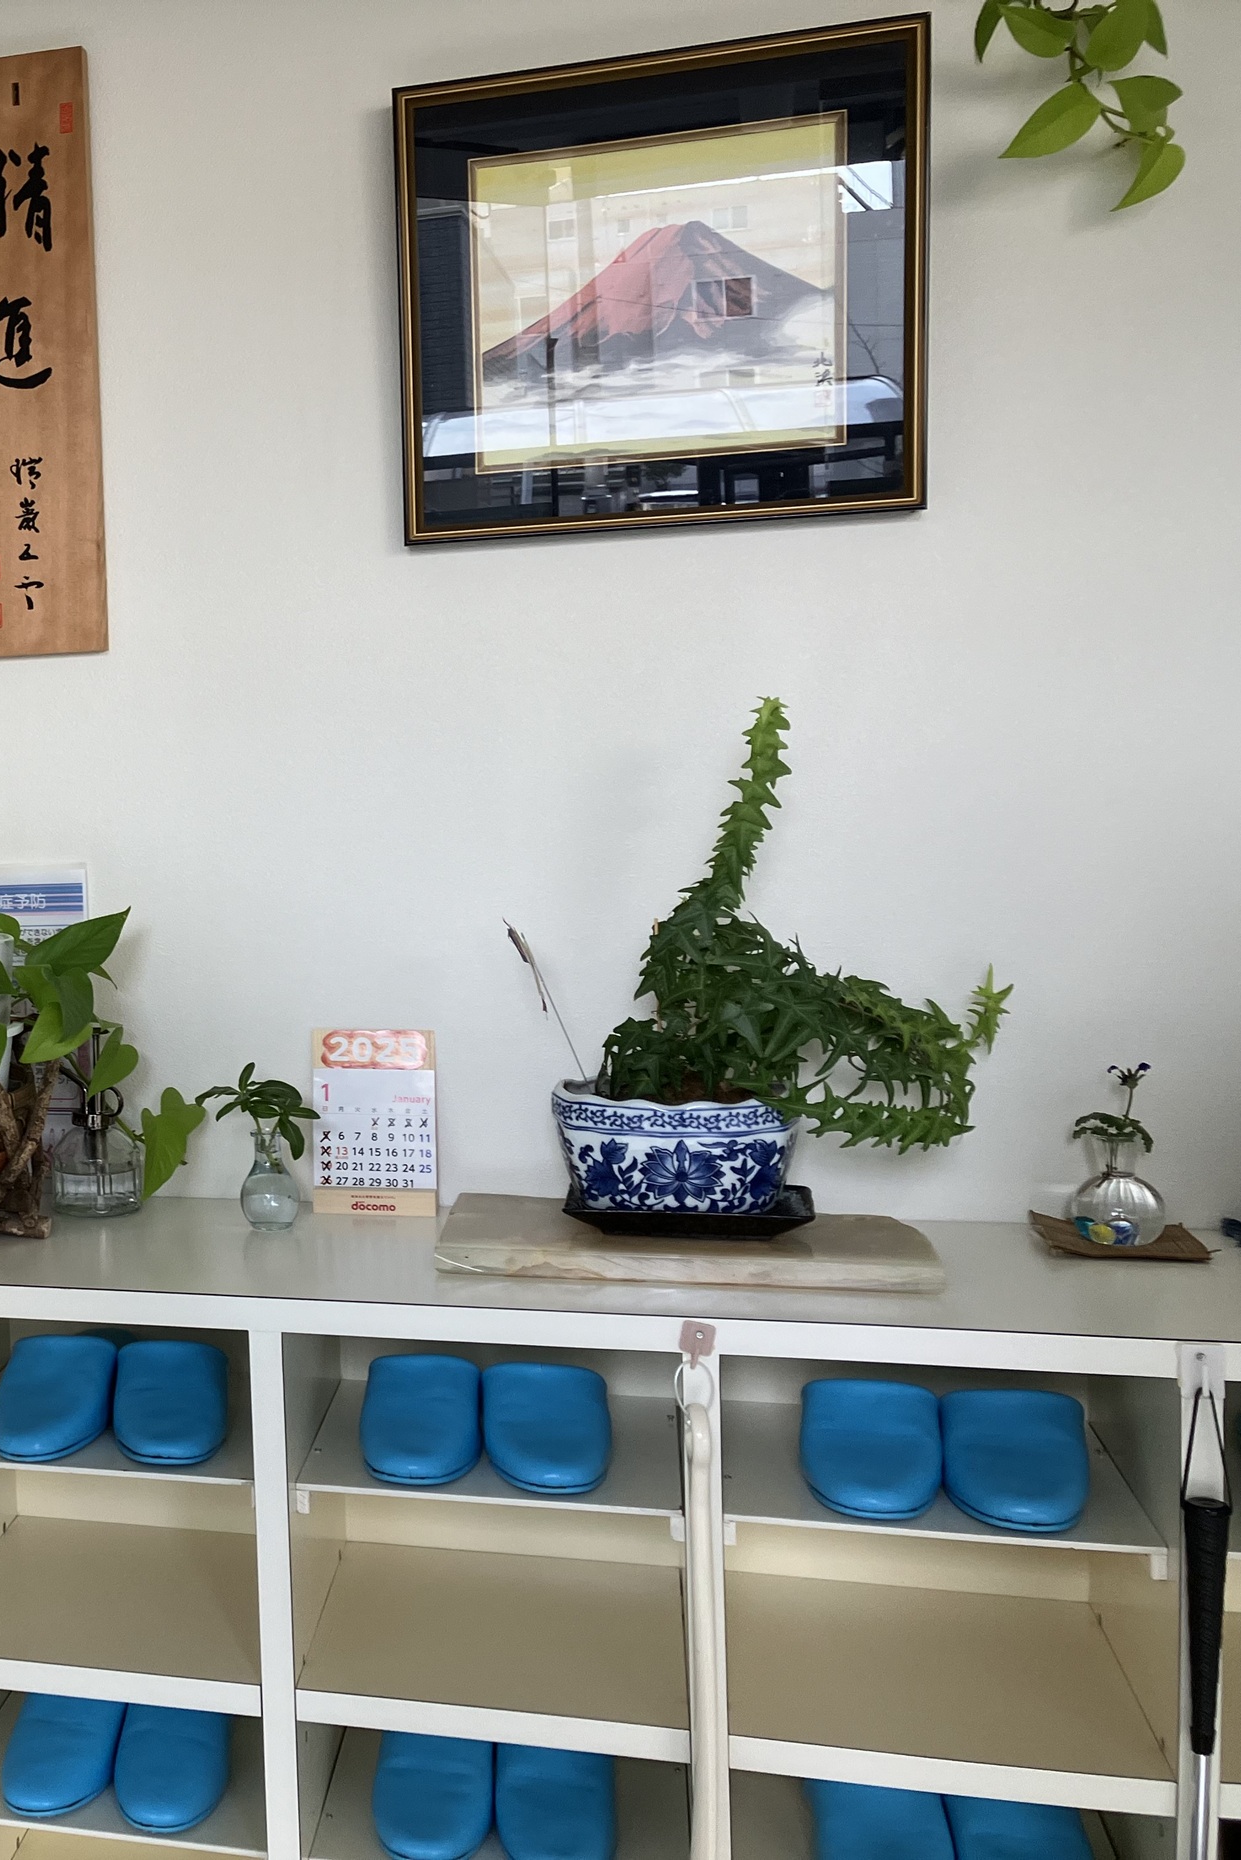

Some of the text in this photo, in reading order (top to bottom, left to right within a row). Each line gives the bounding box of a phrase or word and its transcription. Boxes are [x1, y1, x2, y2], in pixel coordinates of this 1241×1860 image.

[329, 1036, 419, 1063] 2025
[321, 1083, 329, 1101] 1
[392, 1095, 431, 1106] January
[339, 1131, 345, 1140] 6
[355, 1132, 361, 1140] 7
[371, 1132, 378, 1141] 8
[388, 1133, 395, 1141] 9
[403, 1133, 415, 1142] 10
[419, 1134, 431, 1142] 11
[336, 1146, 348, 1155] 13
[352, 1147, 364, 1156] 14
[369, 1147, 381, 1157] 15
[385, 1148, 398, 1157] 16
[403, 1149, 415, 1157] 17
[419, 1149, 432, 1158] 18
[336, 1162, 349, 1171] 20
[352, 1162, 363, 1171] 21
[369, 1163, 382, 1172] 22
[385, 1163, 398, 1172] 23
[402, 1164, 415, 1173] 24
[419, 1164, 432, 1173] 25
[336, 1176, 348, 1185] 27
[352, 1177, 365, 1186] 28
[369, 1178, 382, 1187] 29
[385, 1179, 398, 1187] 30
[402, 1179, 414, 1188] 31
[351, 1201, 396, 1211] docomo
